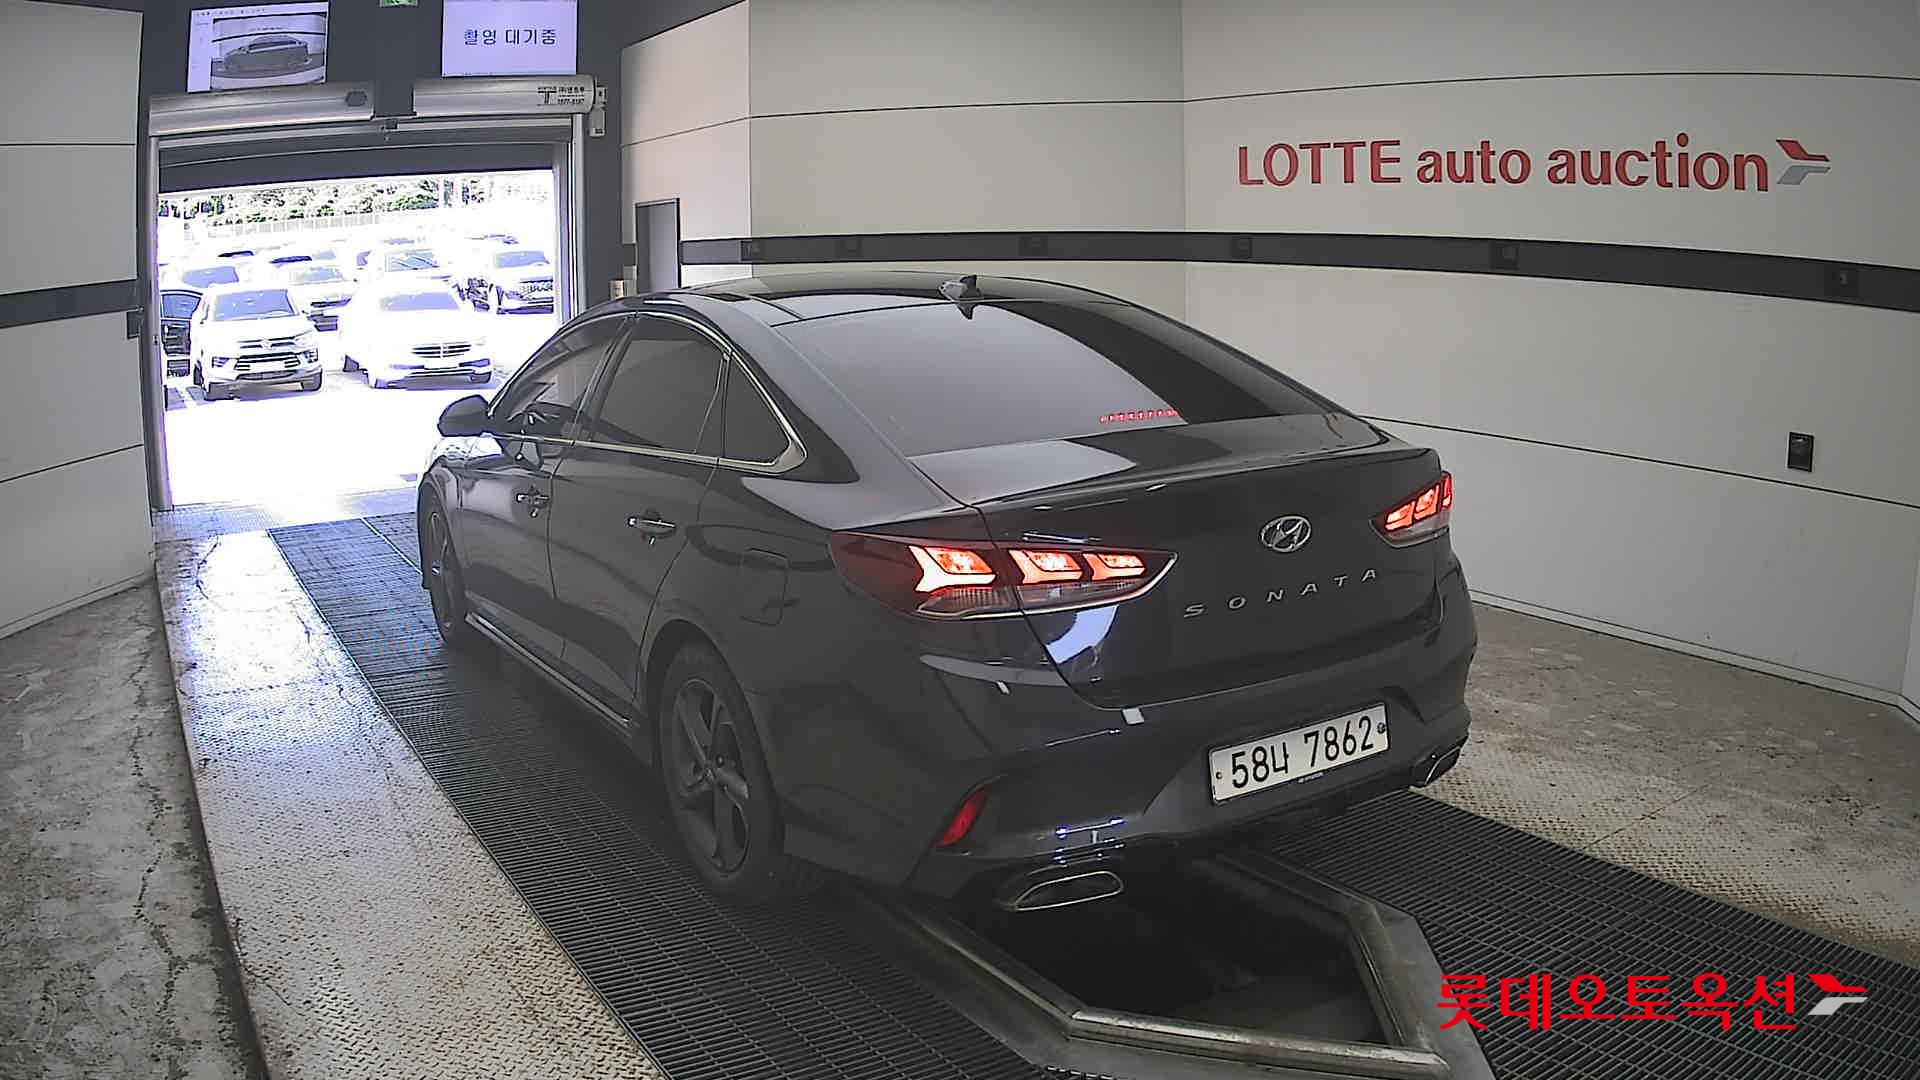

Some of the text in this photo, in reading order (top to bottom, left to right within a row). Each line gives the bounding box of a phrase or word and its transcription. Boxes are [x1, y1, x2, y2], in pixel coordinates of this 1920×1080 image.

[463, 28, 557, 46] 촬영 대기중
[1238, 133, 1769, 192] LOTTE auto auction
[1183, 568, 1378, 618] SONATA
[1231, 715, 1375, 789] 58나 7862
